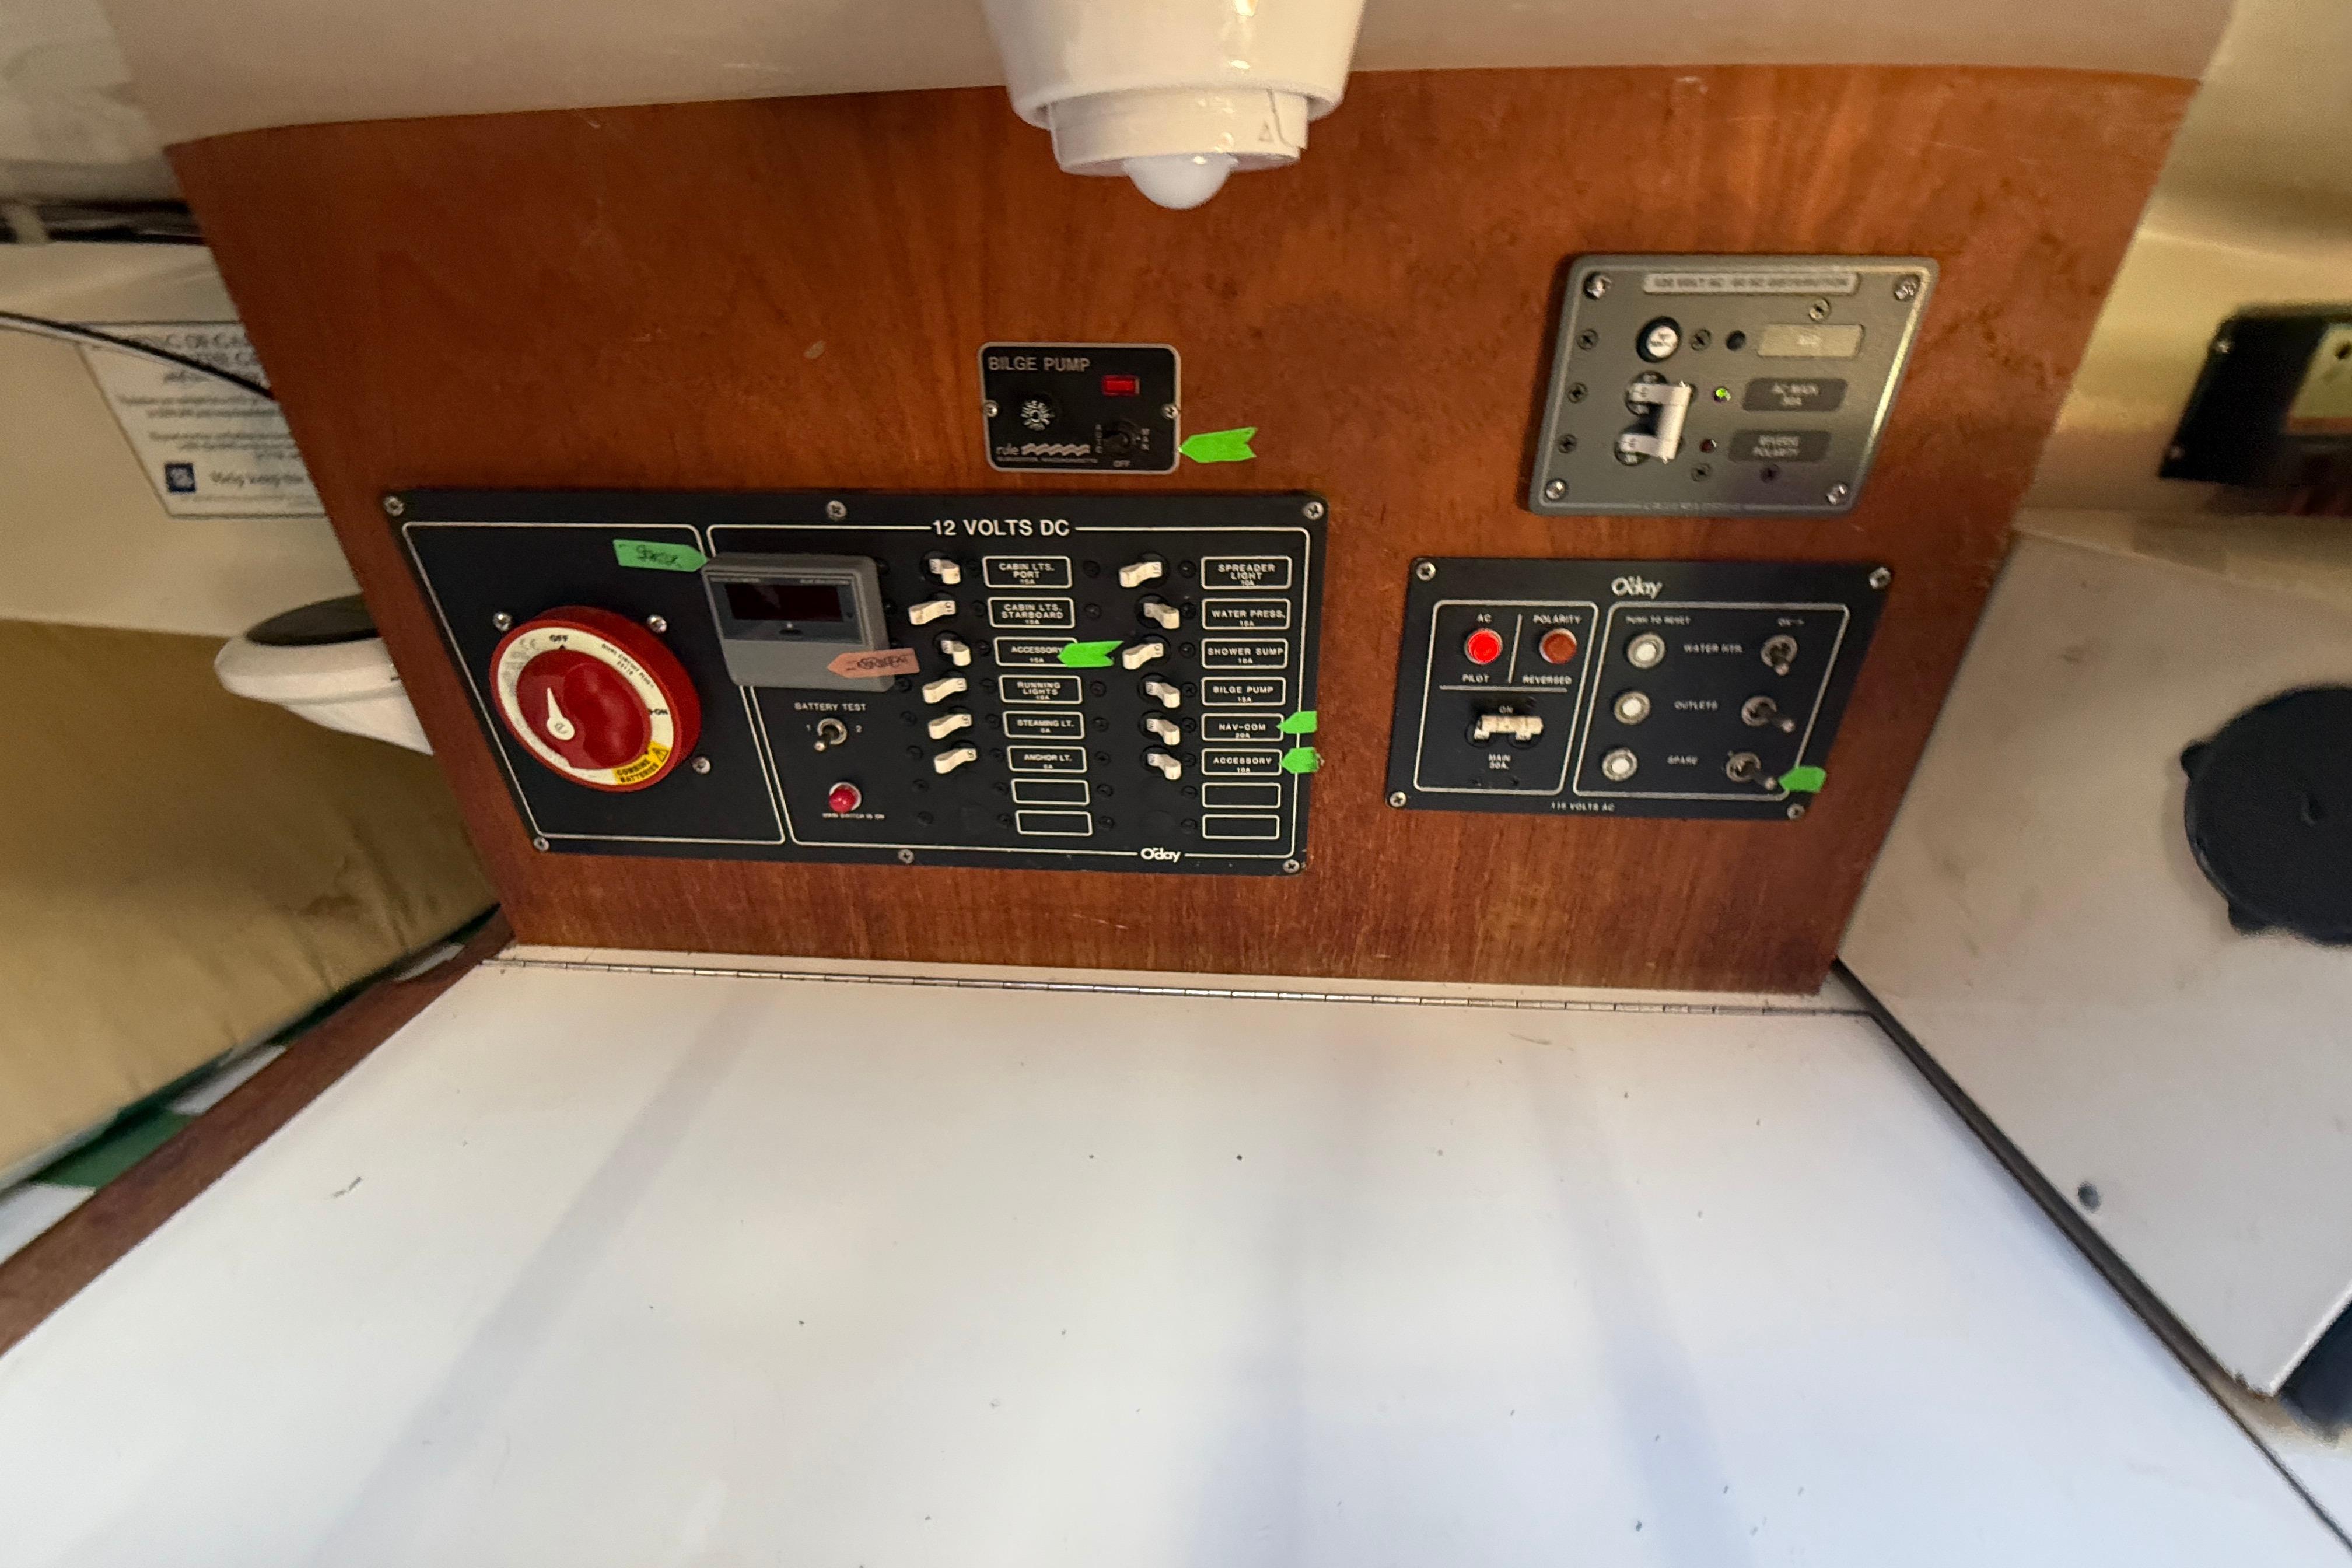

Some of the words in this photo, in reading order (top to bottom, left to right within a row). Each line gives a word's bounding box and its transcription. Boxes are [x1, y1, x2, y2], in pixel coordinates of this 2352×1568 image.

[988, 356, 1038, 371] BILGE
[1044, 357, 1090, 372] PUMP
[933, 519, 957, 536] 12
[963, 519, 1033, 536] VOLTS
[1040, 519, 1070, 536] DC
[998, 563, 1030, 571] CABIN
[1032, 563, 1055, 572] LTS.
[1217, 564, 1276, 572] SPREADER
[1231, 572, 1263, 580] LIGHT
[1003, 603, 1035, 611] CABIN
[1039, 603, 1063, 612] LTS.
[1001, 611, 1064, 620] STARBOARD
[1211, 610, 1247, 618] WATER
[1250, 610, 1286, 619] PRESS.
[1477, 614, 1492, 623] AC
[1533, 614, 1582, 624] POLARITY
[1207, 648, 1251, 656] SHOWER
[1255, 648, 1284, 656] SUMP
[1683, 643, 1719, 653] WATER
[1462, 673, 1490, 683] PILOT
[1521, 674, 1573, 685] REVERSED
[1213, 686, 1243, 694] BILGE
[794, 702, 840, 711] BATTERY
[842, 703, 867, 712] TEST
[1499, 705, 1514, 713] ON
[1674, 701, 1718, 710] OUTLETS
[1017, 719, 1059, 727] STEAMING
[1061, 720, 1074, 728] LT.
[1218, 723, 1266, 732] NAV-COM
[855, 724, 862, 733] 2
[1024, 754, 1058, 762] ANCHOR
[617, 758, 652, 776] COMBINE
[620, 762, 659, 783] BATTERIES
[1569, 802, 1600, 811] VOLTS
[1602, 803, 1615, 812] AC
